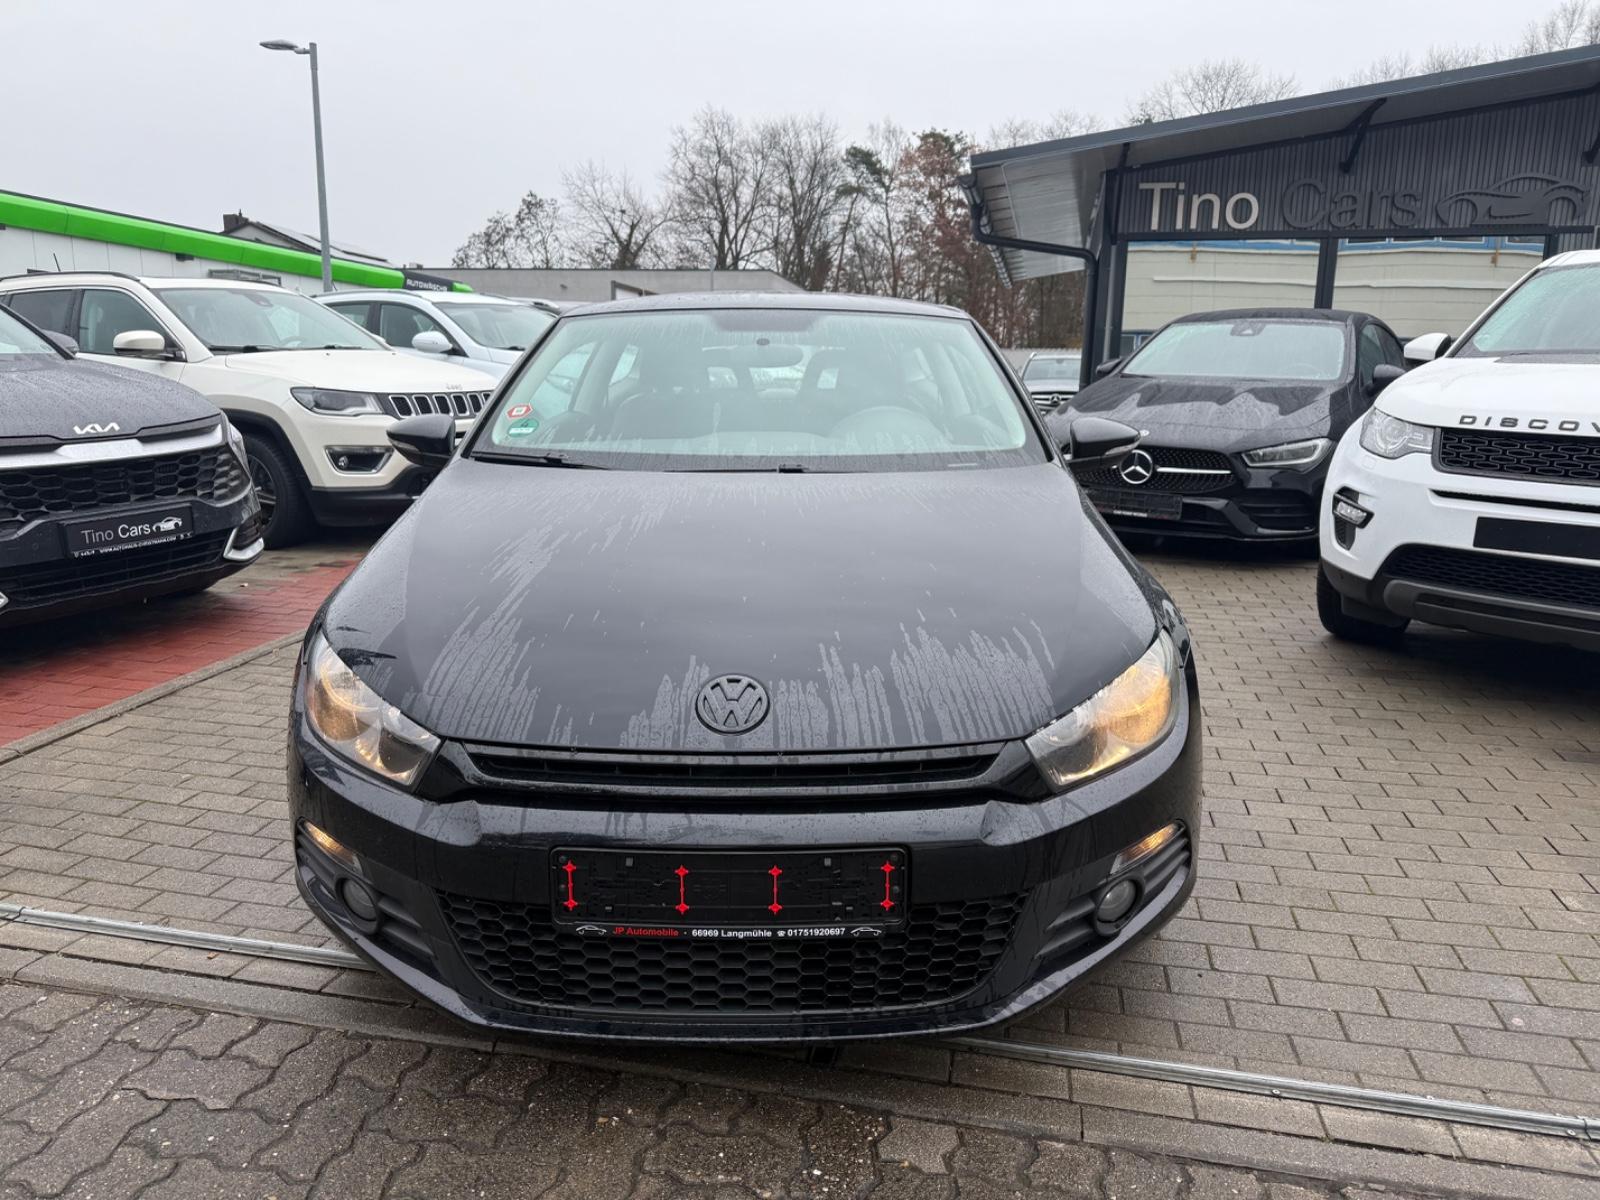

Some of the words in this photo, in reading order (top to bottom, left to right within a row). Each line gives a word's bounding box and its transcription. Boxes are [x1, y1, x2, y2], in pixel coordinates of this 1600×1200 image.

[1139, 181, 1259, 231] Tino
[1282, 178, 1422, 228] Cars
[81, 529, 114, 544] Tino
[118, 523, 151, 538] Cars
[612, 926, 625, 935] JP
[626, 927, 679, 937] Automobile
[691, 928, 719, 937] 66969
[720, 928, 772, 939] Langmühle
[787, 927, 846, 937] 01751920697
